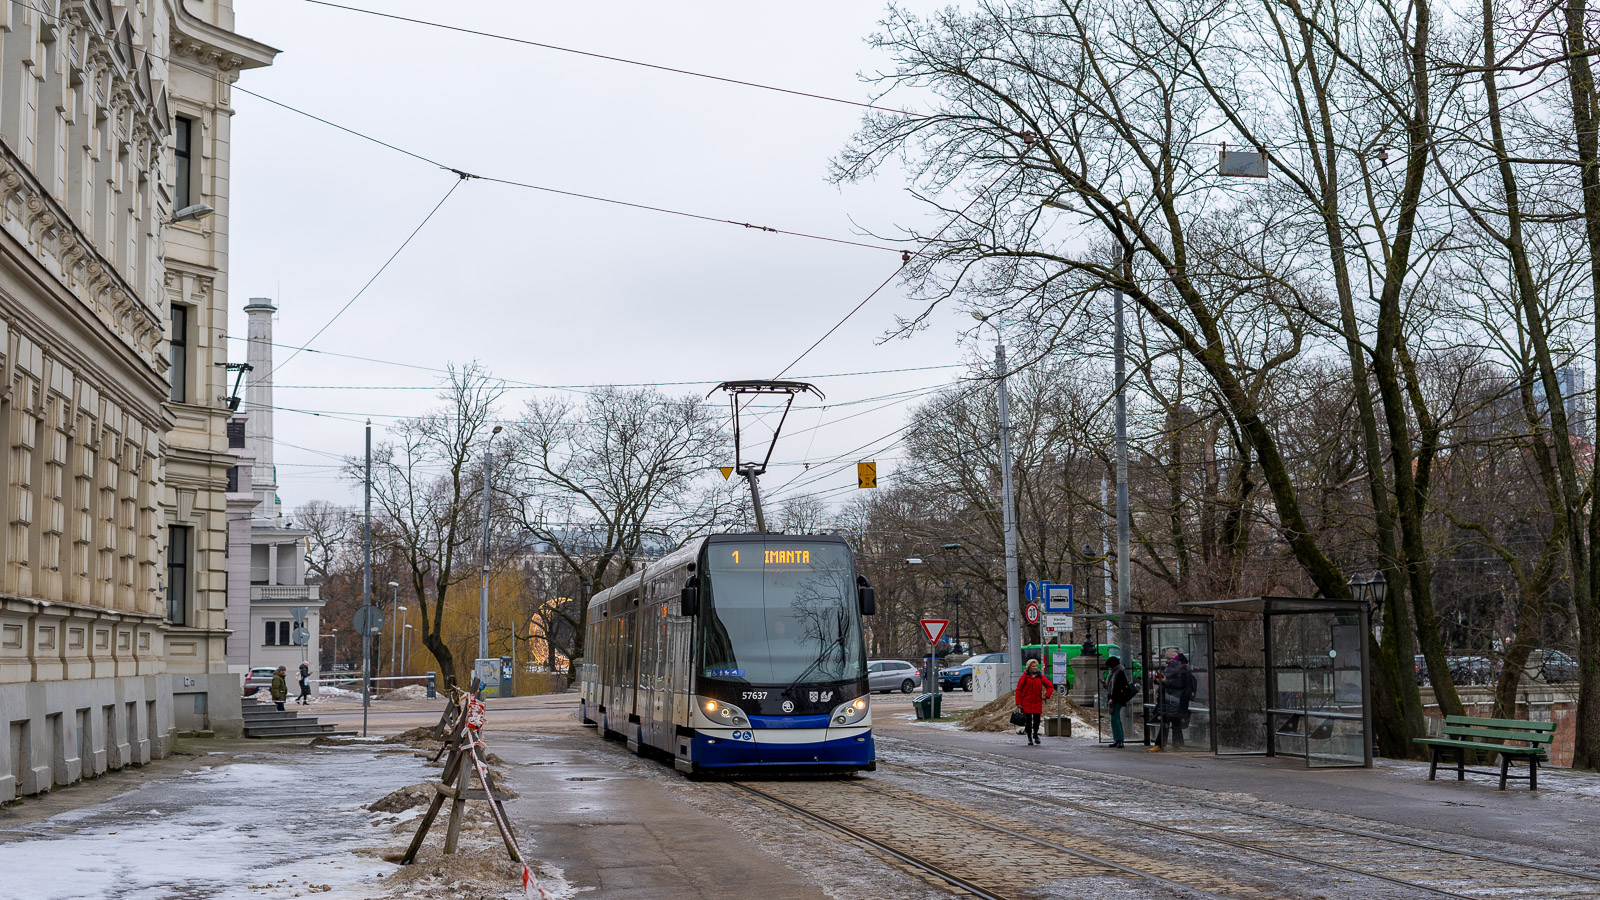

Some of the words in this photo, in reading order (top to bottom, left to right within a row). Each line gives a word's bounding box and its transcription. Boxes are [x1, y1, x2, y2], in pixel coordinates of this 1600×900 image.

[731, 550, 739, 564] 1
[764, 550, 810, 564] IMANTA
[1029, 607, 1036, 619] 30
[742, 691, 768, 700] 57637
